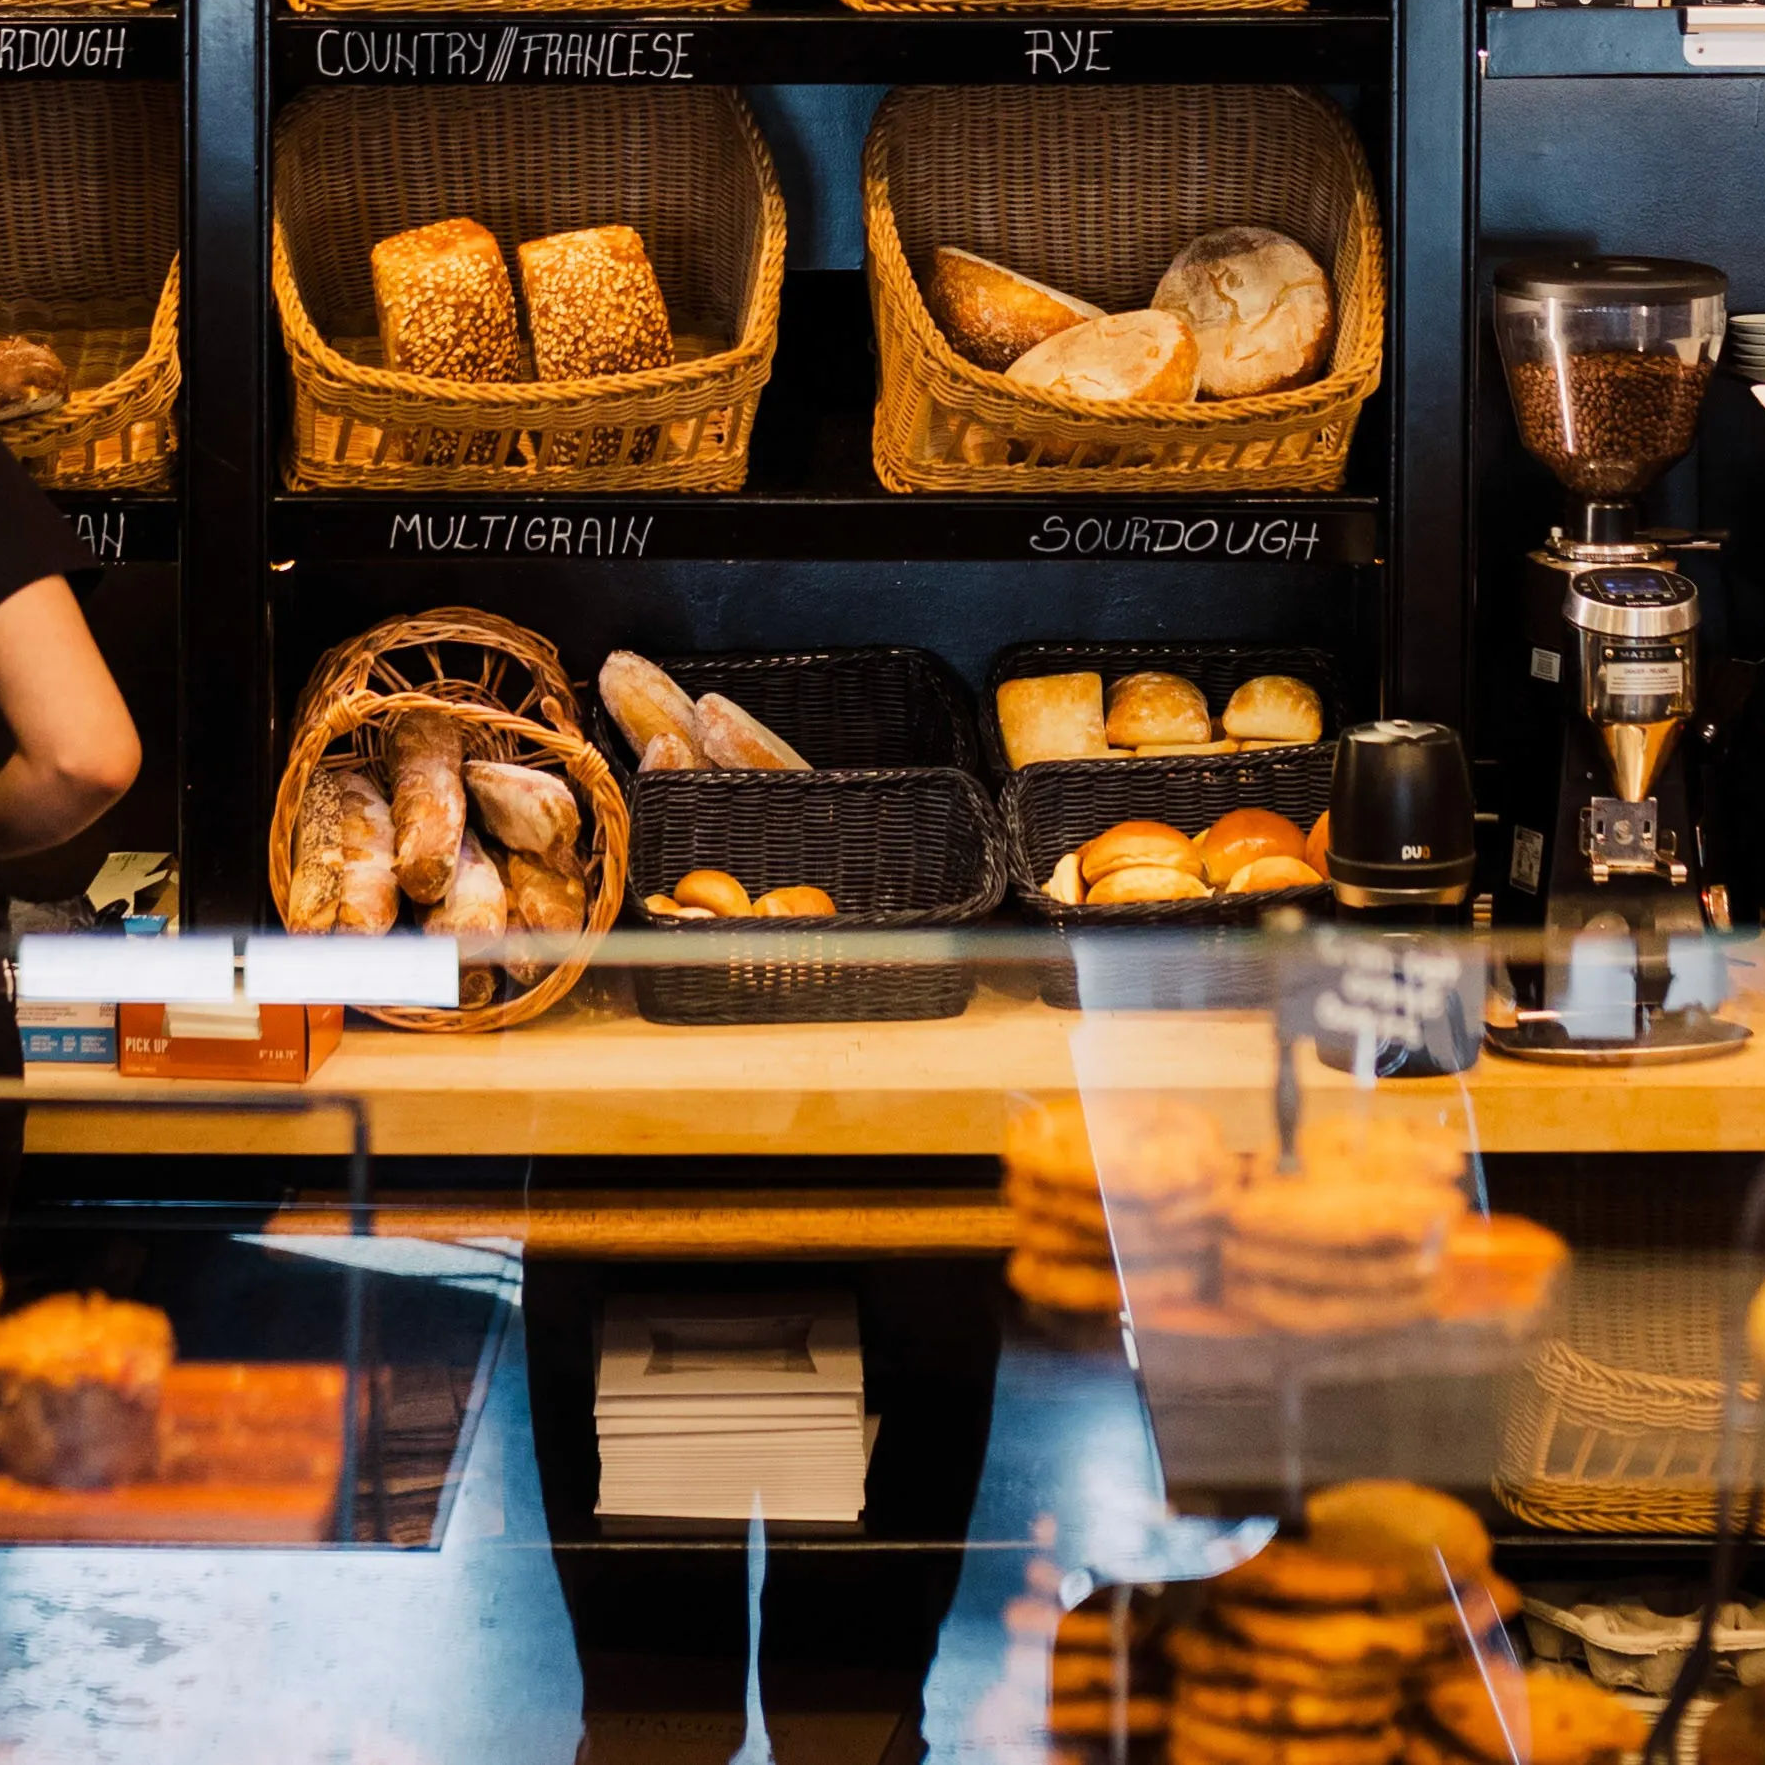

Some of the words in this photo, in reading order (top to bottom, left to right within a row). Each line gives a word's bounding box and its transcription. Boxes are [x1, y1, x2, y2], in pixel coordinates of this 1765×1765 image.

[1024, 29, 1112, 75] RYE
[389, 514, 653, 557] MULTIGRAIN
[1029, 515, 1320, 562] SOURDOUGH
[125, 1036, 150, 1053] PICK
